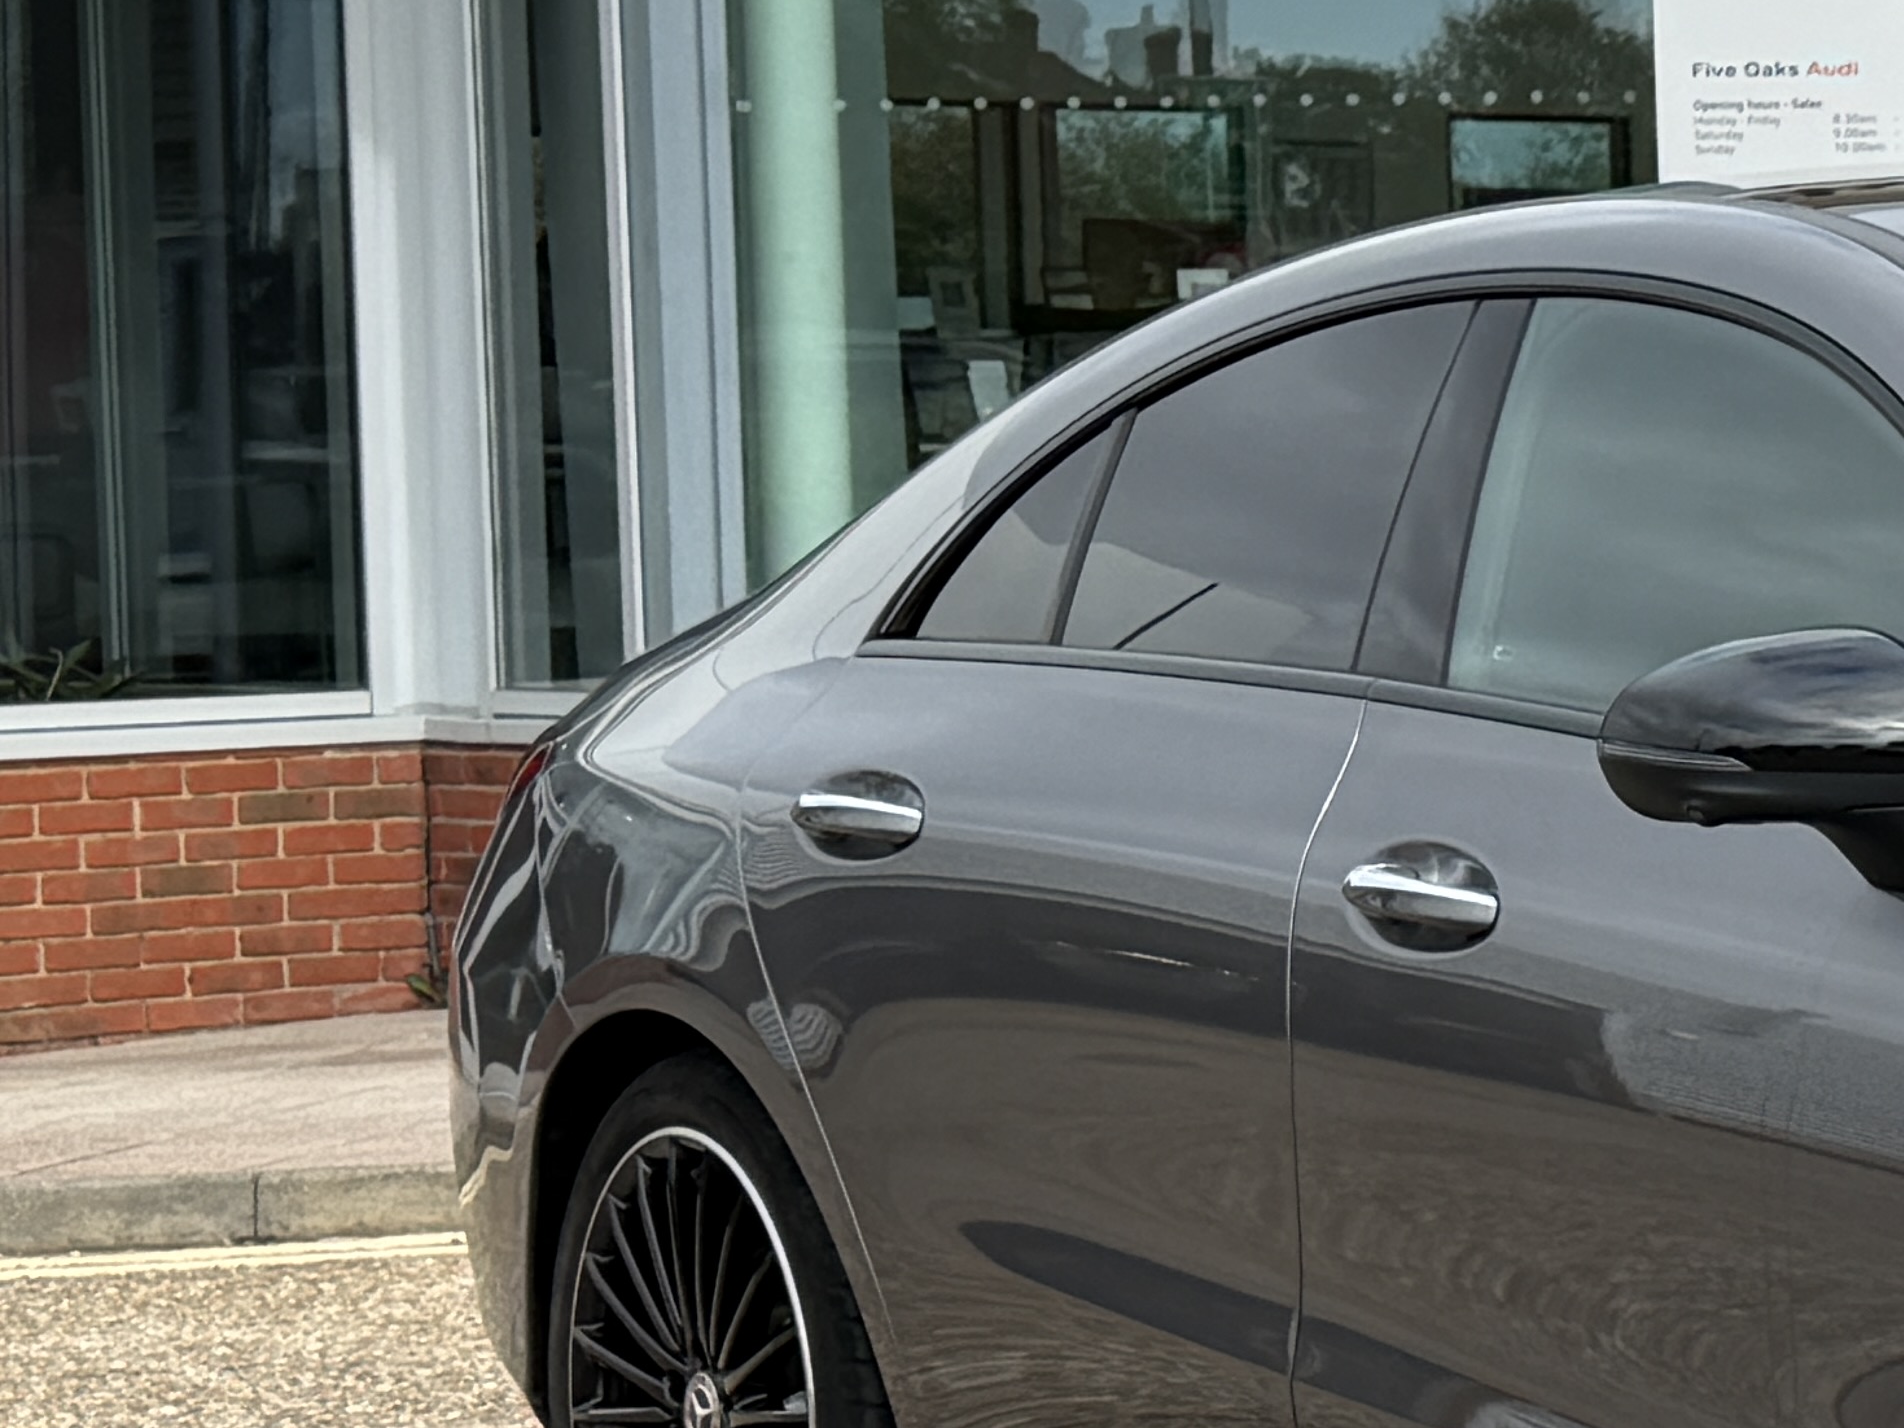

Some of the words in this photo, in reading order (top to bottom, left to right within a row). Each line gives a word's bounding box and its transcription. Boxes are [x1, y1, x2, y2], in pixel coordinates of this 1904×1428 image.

[1692, 62, 1737, 78] Five
[1743, 61, 1799, 78] Oaks
[1806, 60, 1859, 77] Audi
[1693, 99, 1744, 113] Opening
[1747, 99, 1781, 109] hours
